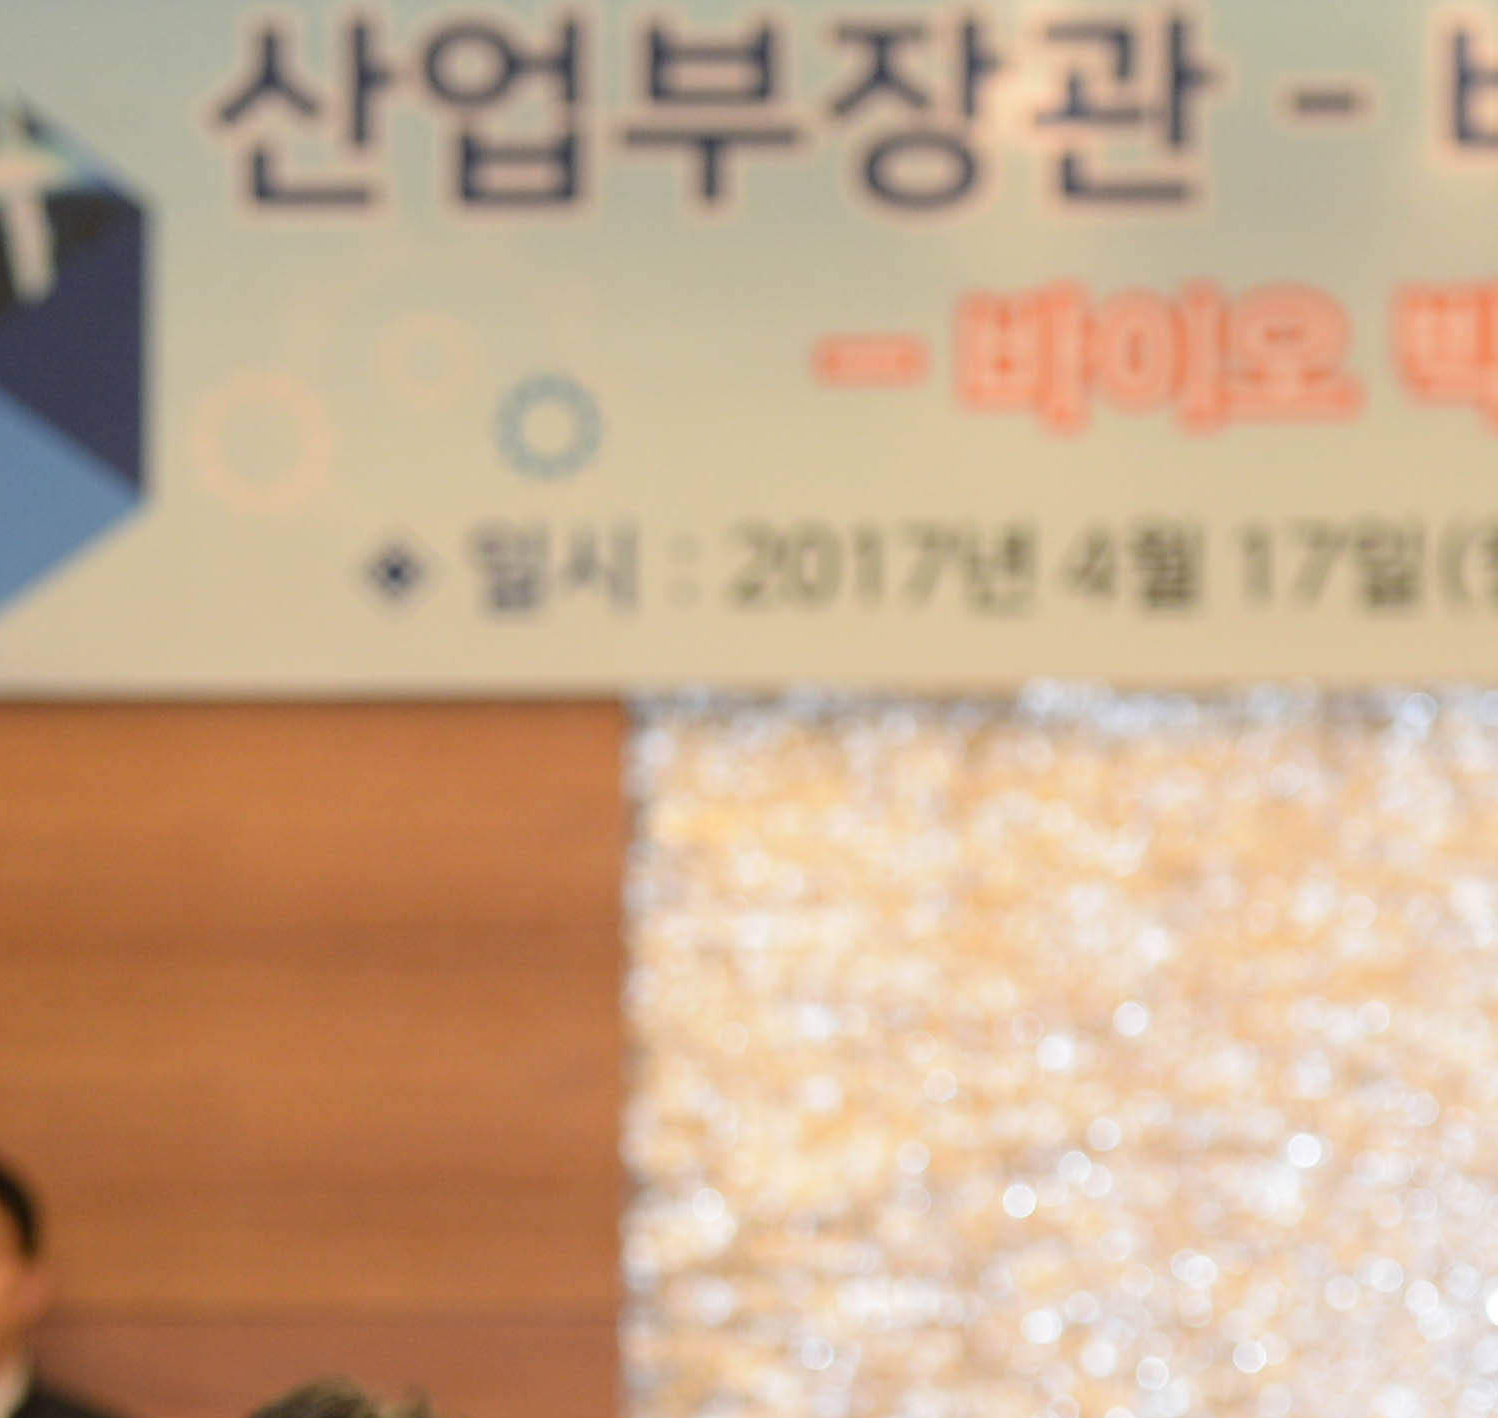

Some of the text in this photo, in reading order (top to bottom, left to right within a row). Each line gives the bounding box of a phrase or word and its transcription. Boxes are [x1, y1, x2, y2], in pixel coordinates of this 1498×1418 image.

[211, 12, 1215, 210] 산업부장관
[951, 278, 1367, 438] 바이오
[467, 518, 643, 614] 일시
[725, 518, 1043, 614] 2017년
[1063, 518, 1207, 610] 4월
